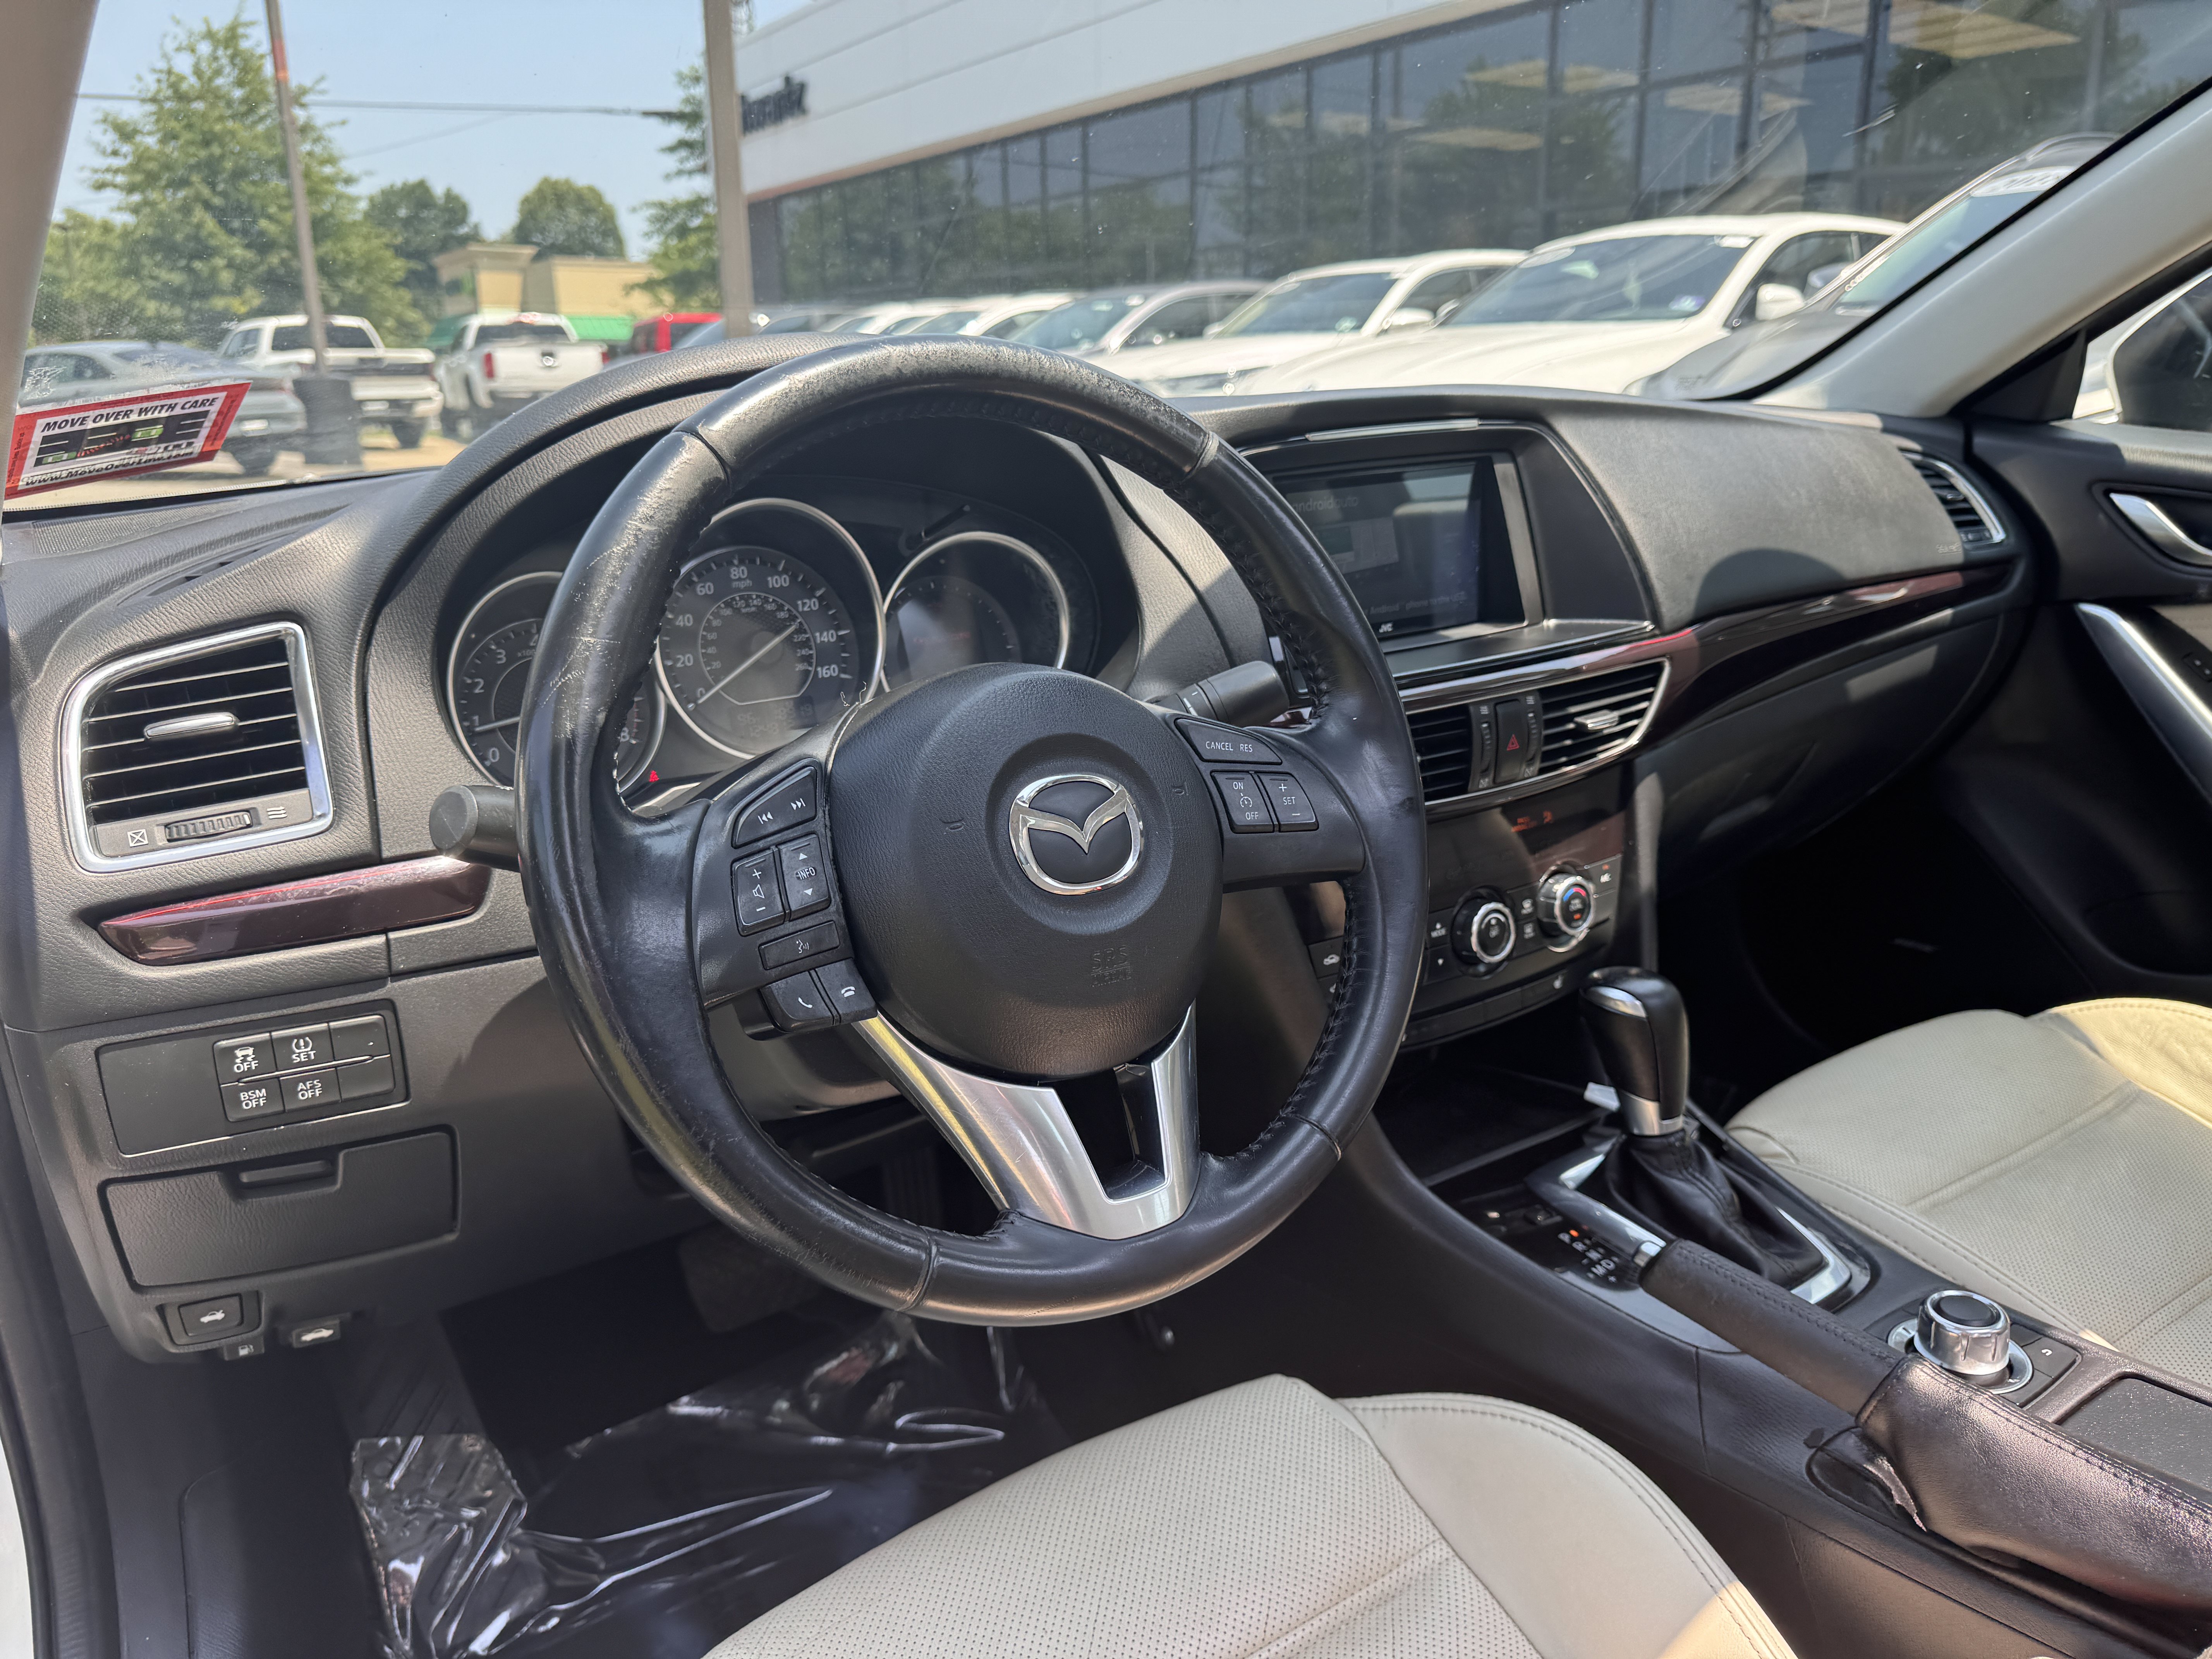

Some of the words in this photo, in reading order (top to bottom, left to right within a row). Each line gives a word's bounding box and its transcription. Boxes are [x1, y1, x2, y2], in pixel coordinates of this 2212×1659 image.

[40, 416, 90, 433] MOVE
[92, 409, 134, 424] OVER
[137, 403, 178, 417] WITH
[181, 397, 219, 410] CARE
[730, 566, 747, 579] 80
[732, 580, 752, 589] mph
[767, 575, 790, 588] 100
[697, 582, 714, 595] 60
[797, 598, 819, 611] 120
[675, 614, 693, 627] 40
[815, 630, 836, 643] 140
[496, 648, 507, 664] 3
[676, 654, 694, 668] 20
[817, 665, 839, 678] 160
[473, 678, 484, 694] 2
[472, 715, 479, 727] 1
[1206, 741, 1233, 751] CANCEL
[1240, 744, 1253, 752] RES
[489, 747, 500, 763] 0
[1283, 797, 1295, 805] SET
[797, 867, 816, 880] INFO
[292, 1051, 316, 1063] SET
[233, 1061, 259, 1073] OFF
[297, 1079, 322, 1091] AFS
[240, 1088, 267, 1101] BSM
[299, 1088, 323, 1100] OFF
[242, 1097, 267, 1110] OFF
[1600, 1259, 1616, 1271] D
